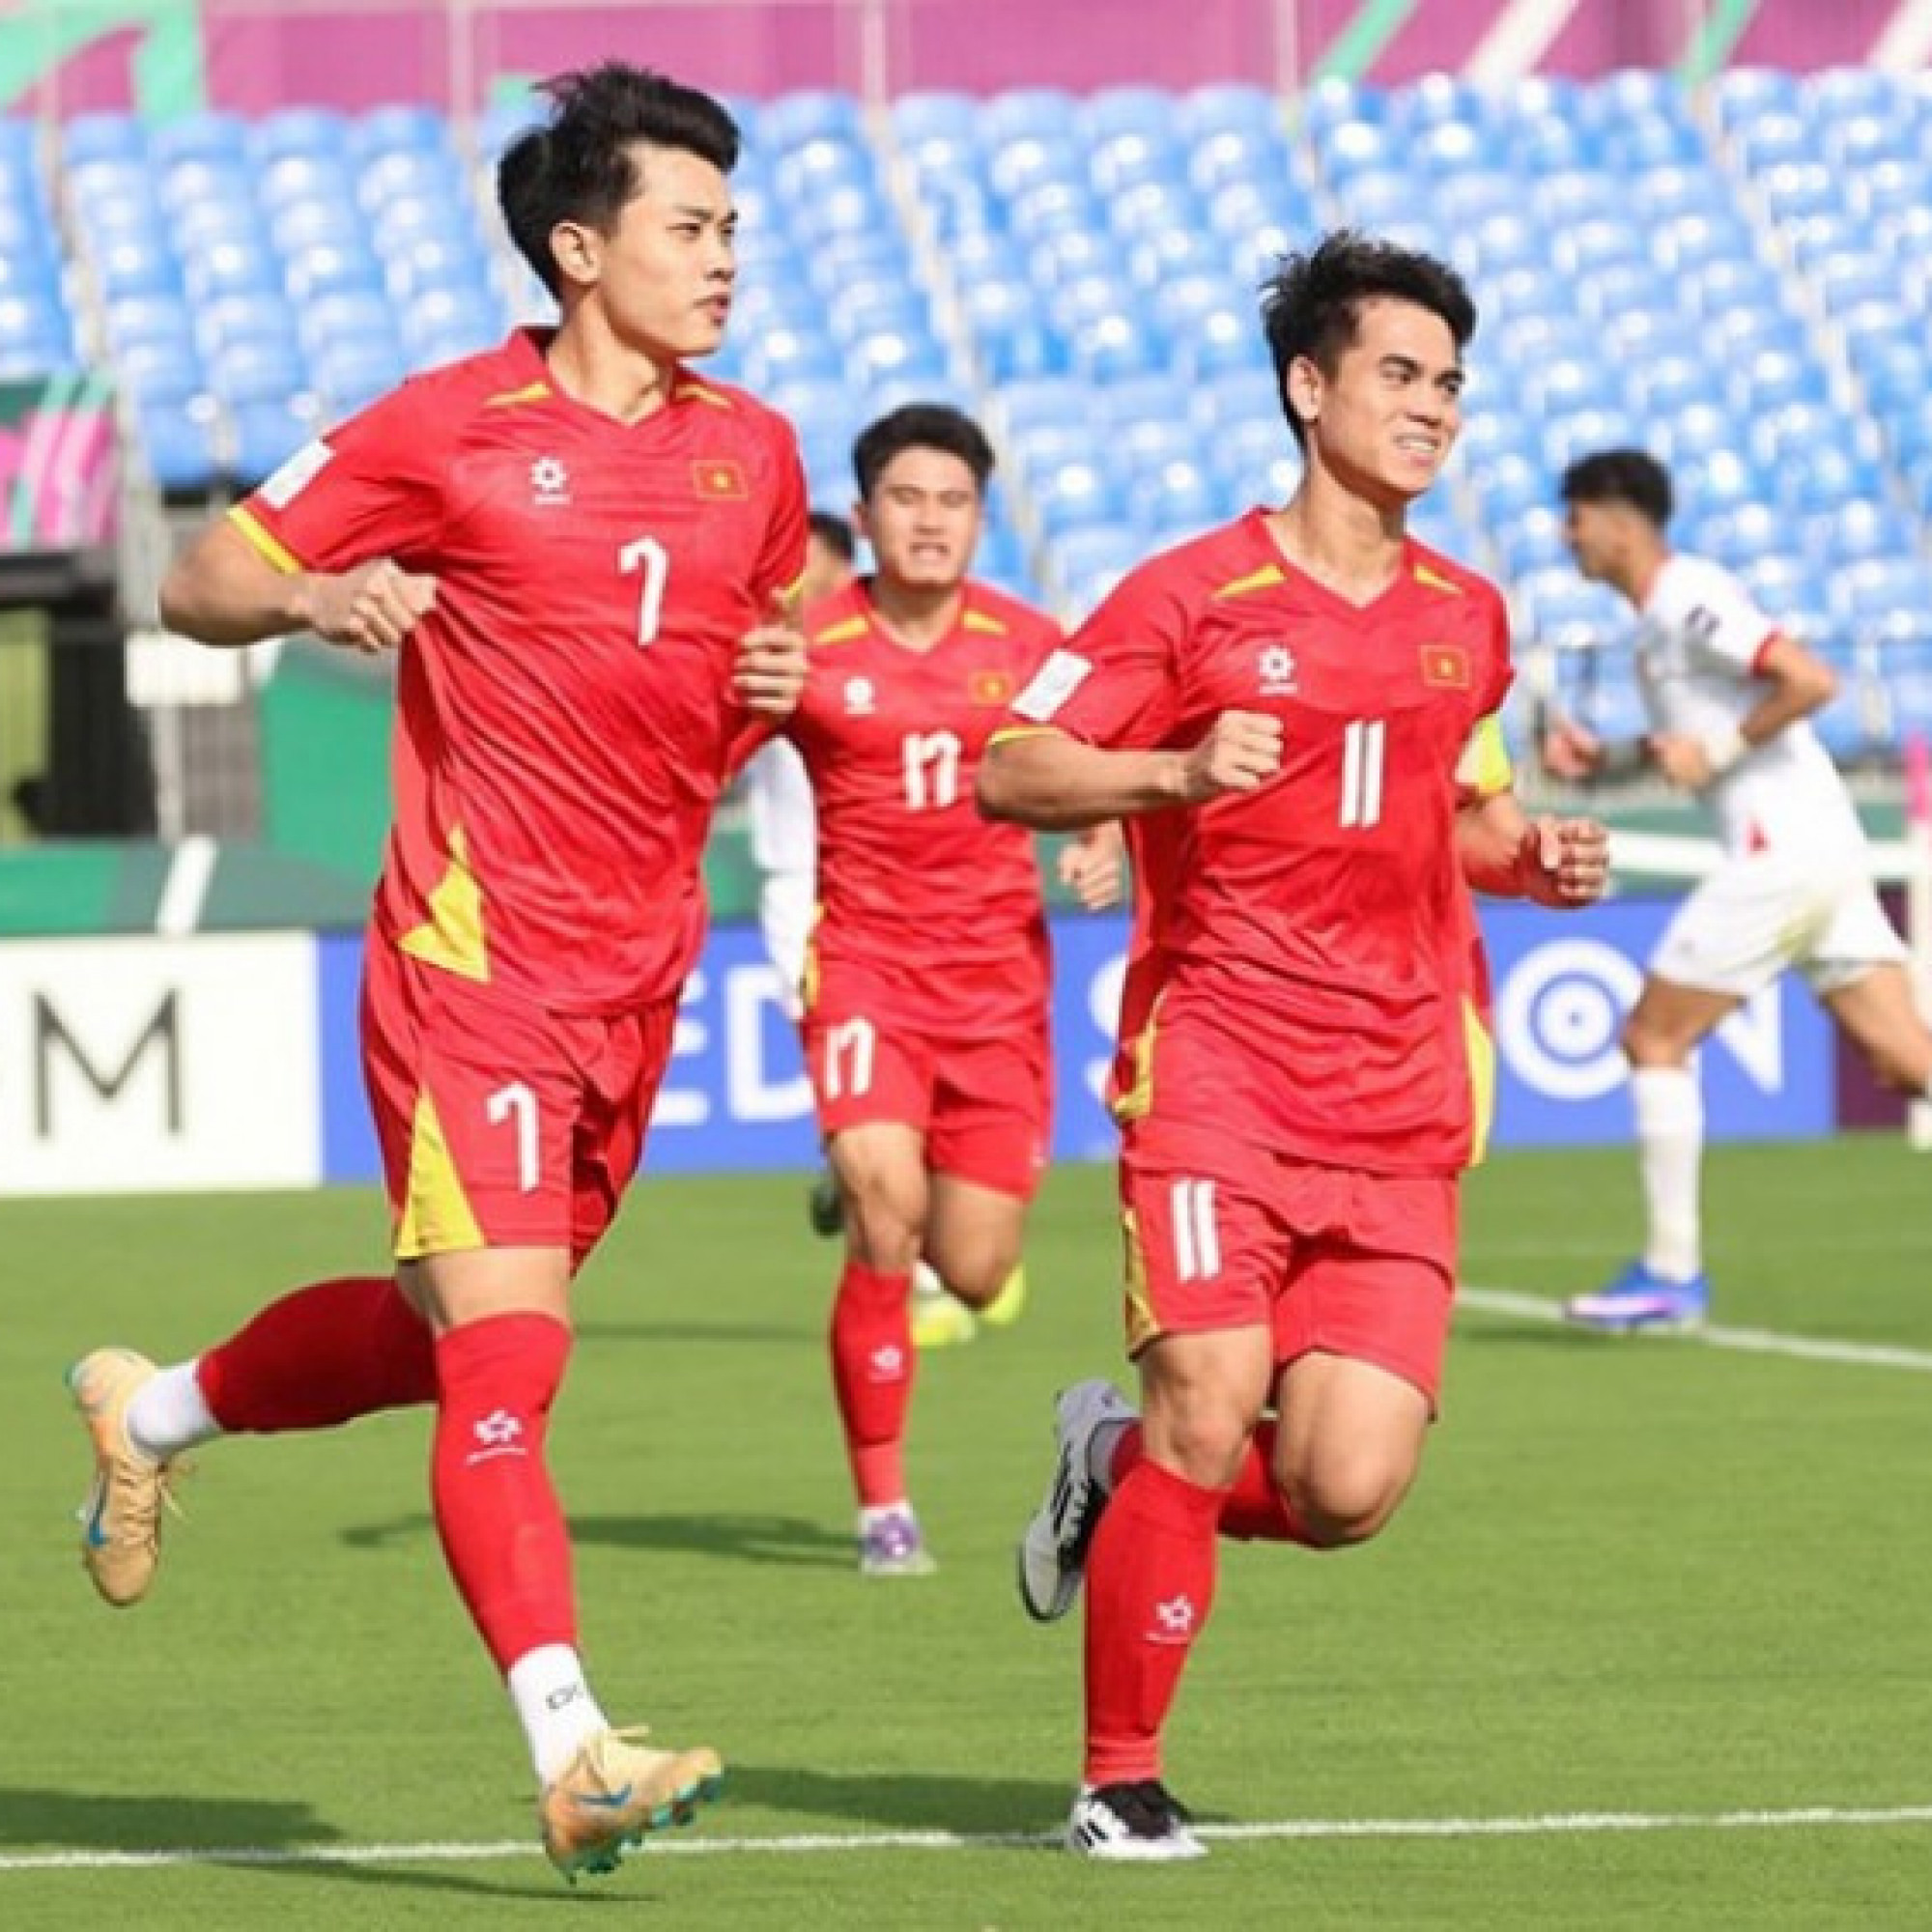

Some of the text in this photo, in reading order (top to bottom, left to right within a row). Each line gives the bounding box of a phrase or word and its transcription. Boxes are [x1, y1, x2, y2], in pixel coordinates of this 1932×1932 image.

[619, 535, 668, 645] 7
[902, 730, 961, 810] 17
[1340, 719, 1385, 829] 11
[32, 985, 181, 1139] M
[825, 1015, 876, 1100] 17
[485, 1080, 541, 1193] 7
[1169, 1179, 1221, 1282] 11
